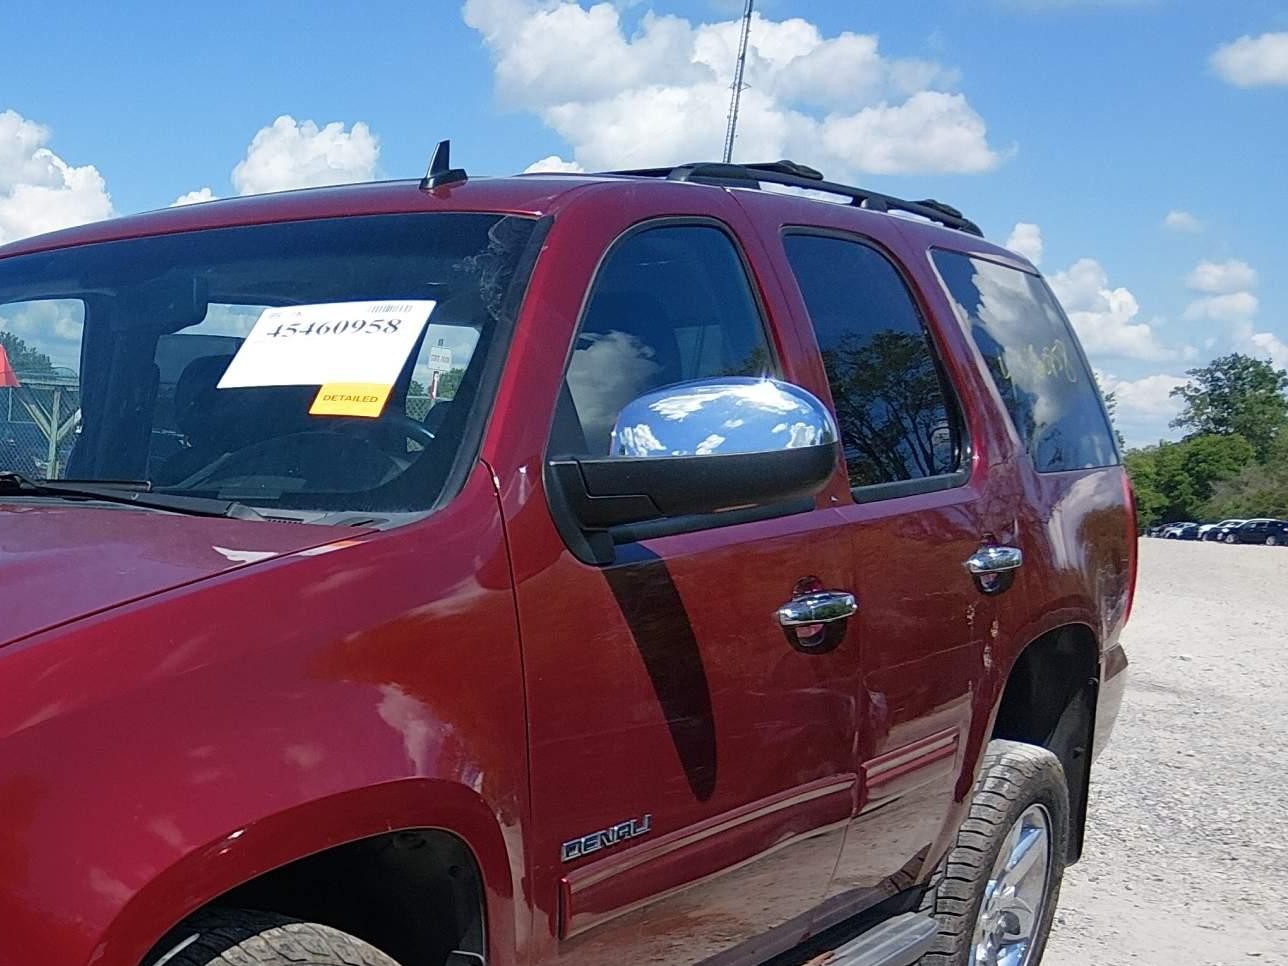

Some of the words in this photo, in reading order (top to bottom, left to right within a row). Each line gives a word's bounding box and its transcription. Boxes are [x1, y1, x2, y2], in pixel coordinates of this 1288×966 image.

[266, 318, 403, 338] 45460958
[323, 394, 379, 403] DETAILED
[561, 813, 652, 862] DENALI
